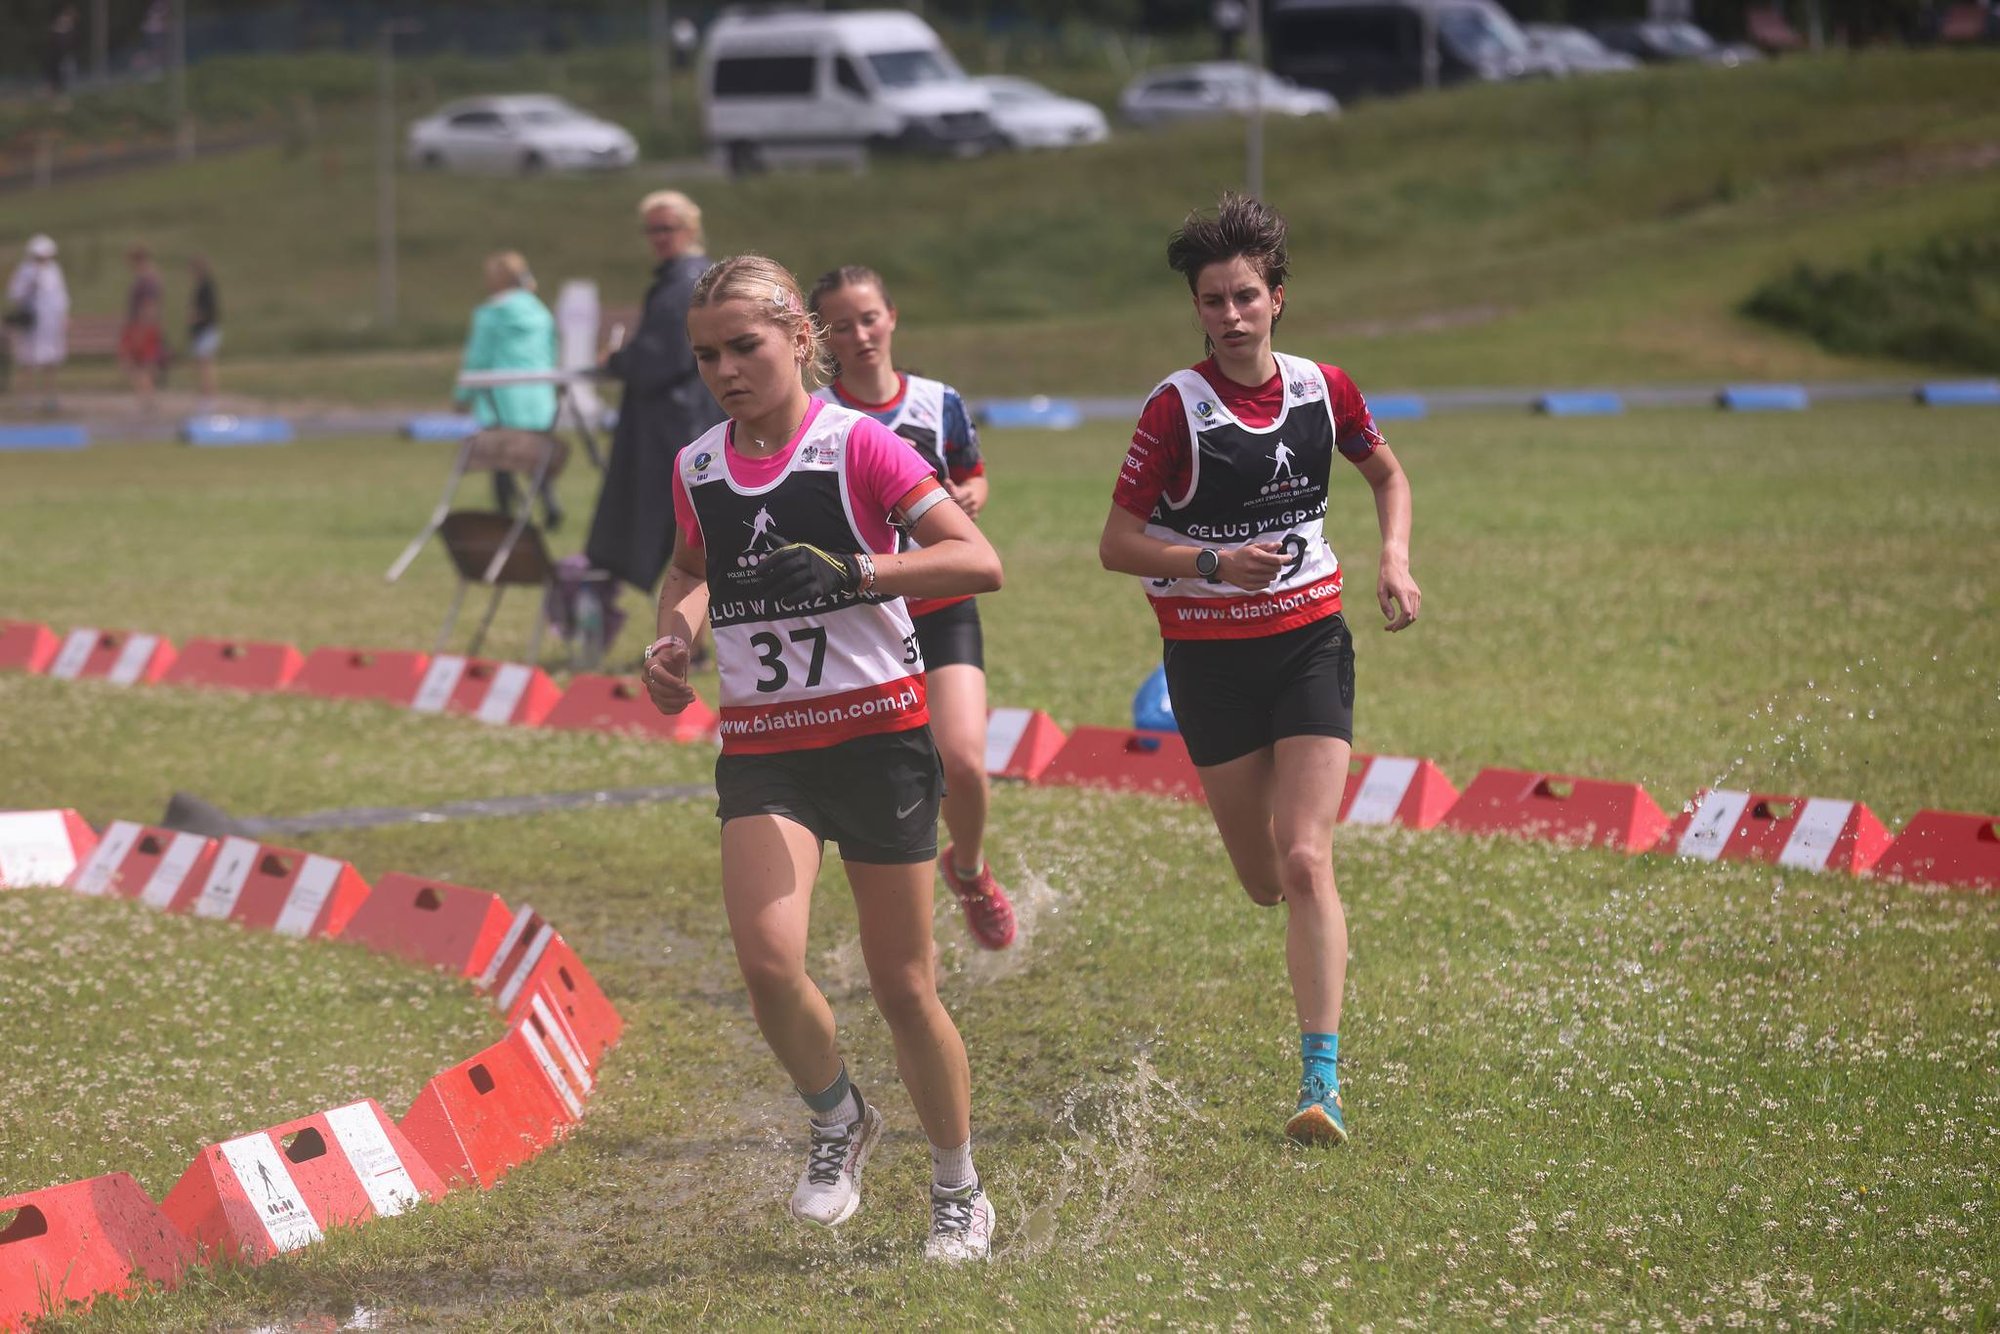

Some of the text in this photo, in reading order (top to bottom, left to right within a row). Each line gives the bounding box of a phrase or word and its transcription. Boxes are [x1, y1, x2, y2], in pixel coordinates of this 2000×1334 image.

[696, 473, 709, 482] IBU
[1187, 522, 1250, 539] CELUJ
[750, 599, 766, 616] W
[749, 626, 828, 693] 37
